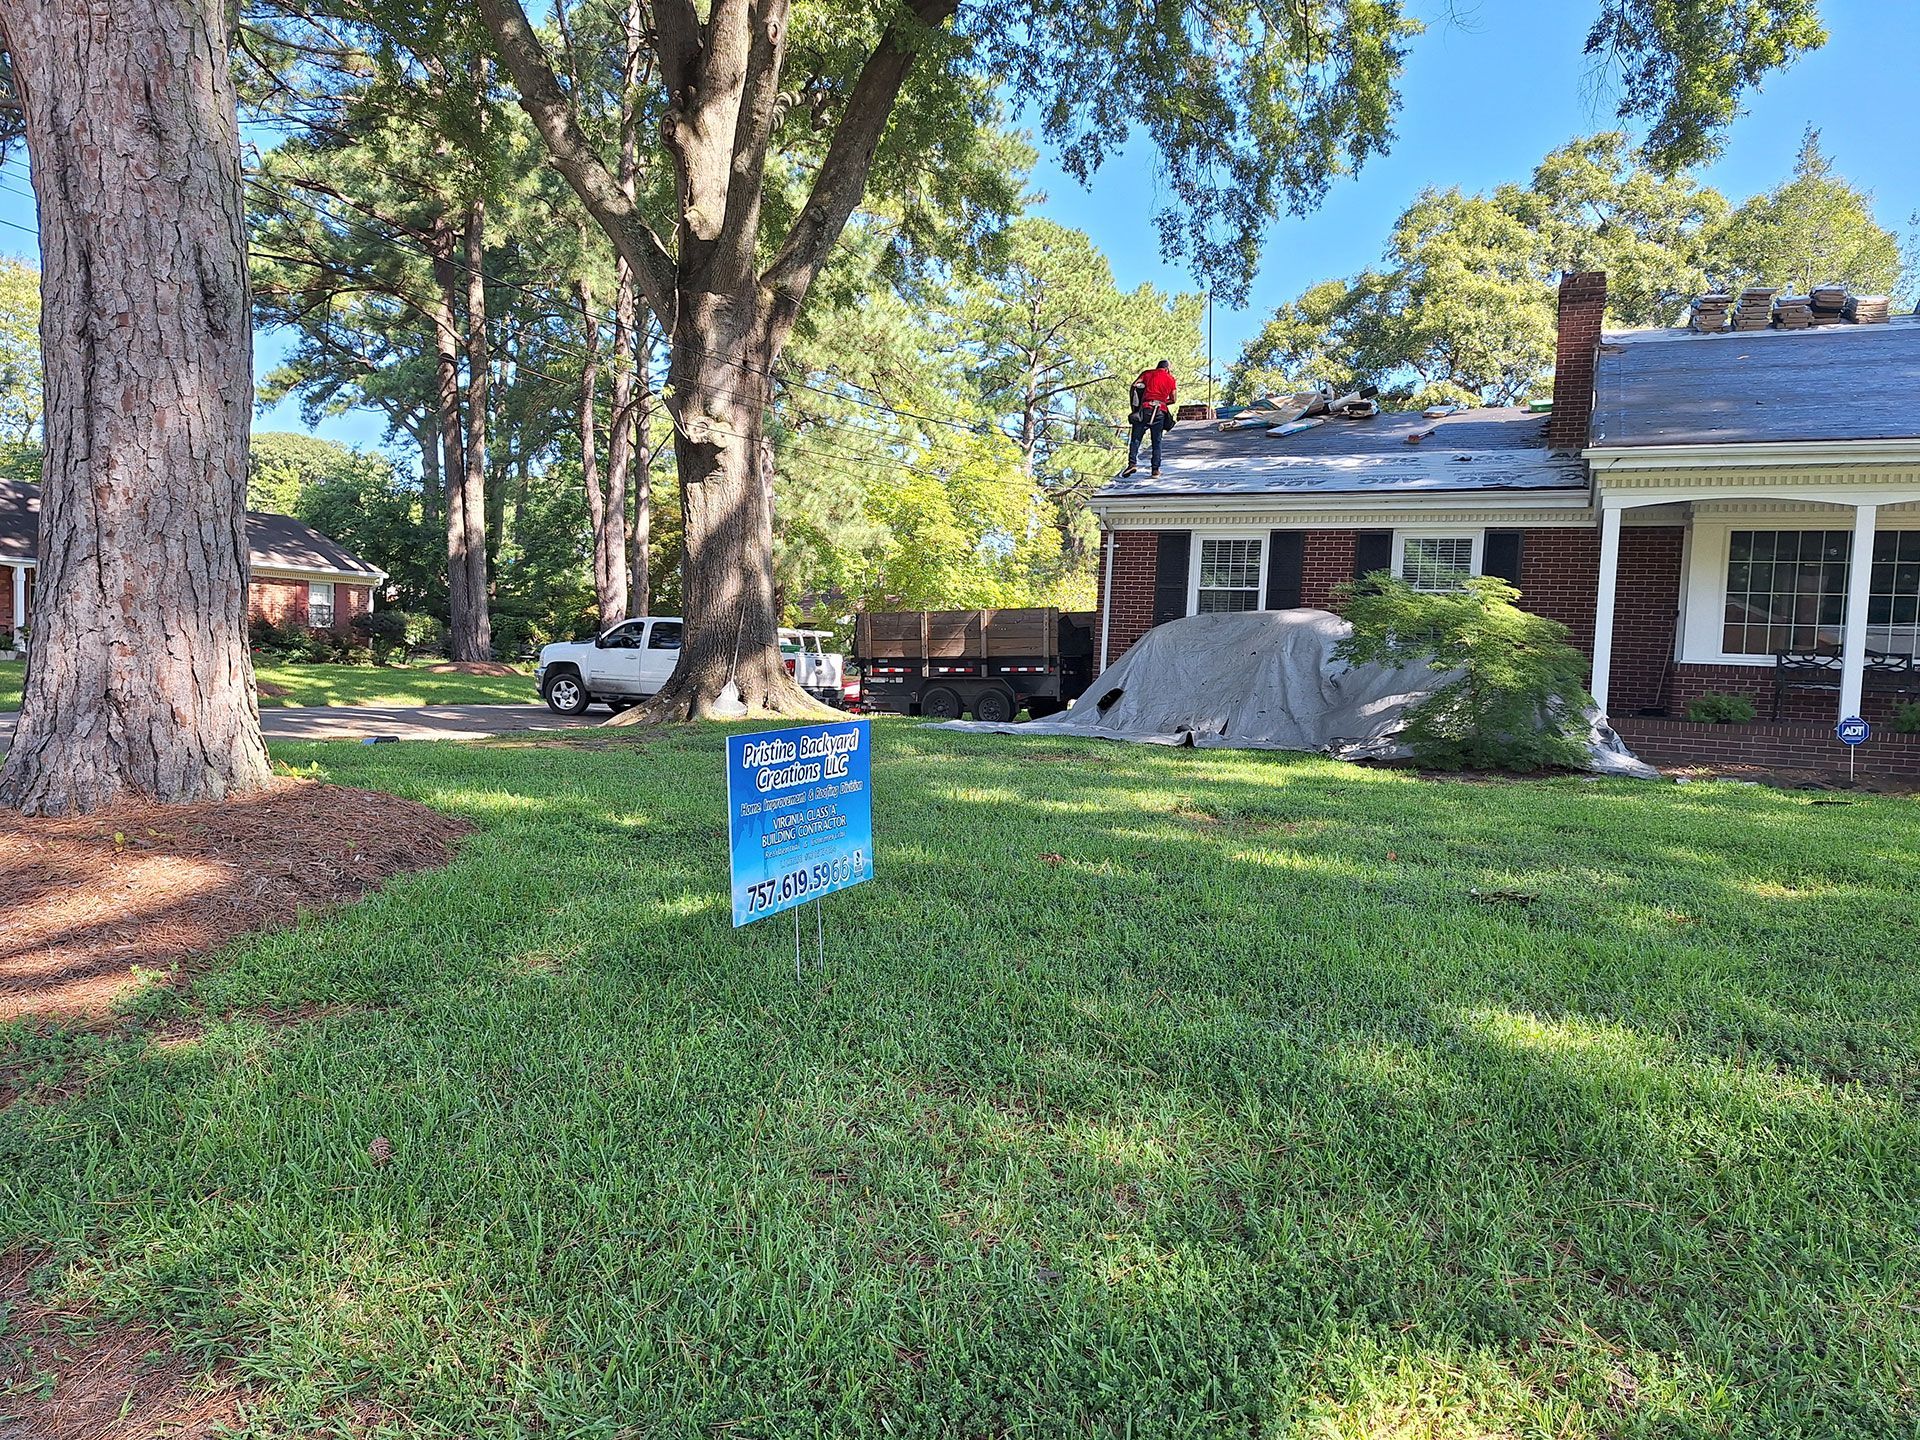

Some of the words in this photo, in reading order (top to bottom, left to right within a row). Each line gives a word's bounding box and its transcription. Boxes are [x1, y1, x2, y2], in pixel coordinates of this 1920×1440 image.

[743, 740, 796, 767] Pristine
[800, 728, 859, 757] Backyard
[1842, 726, 1864, 736] ADT
[757, 762, 820, 791] Creations
[824, 755, 848, 778] LLC
[740, 804, 761, 816] Home
[763, 792, 806, 812] Improvement
[808, 789, 814, 800] &
[815, 785, 839, 799] Roofing
[840, 780, 863, 793] Division
[761, 826, 796, 847] BUILDING
[798, 816, 846, 837] CONTRACTOR
[773, 811, 803, 829] VIRGINIA
[806, 805, 828, 820] CLASS
[747, 855, 850, 913] 757.619.5966
